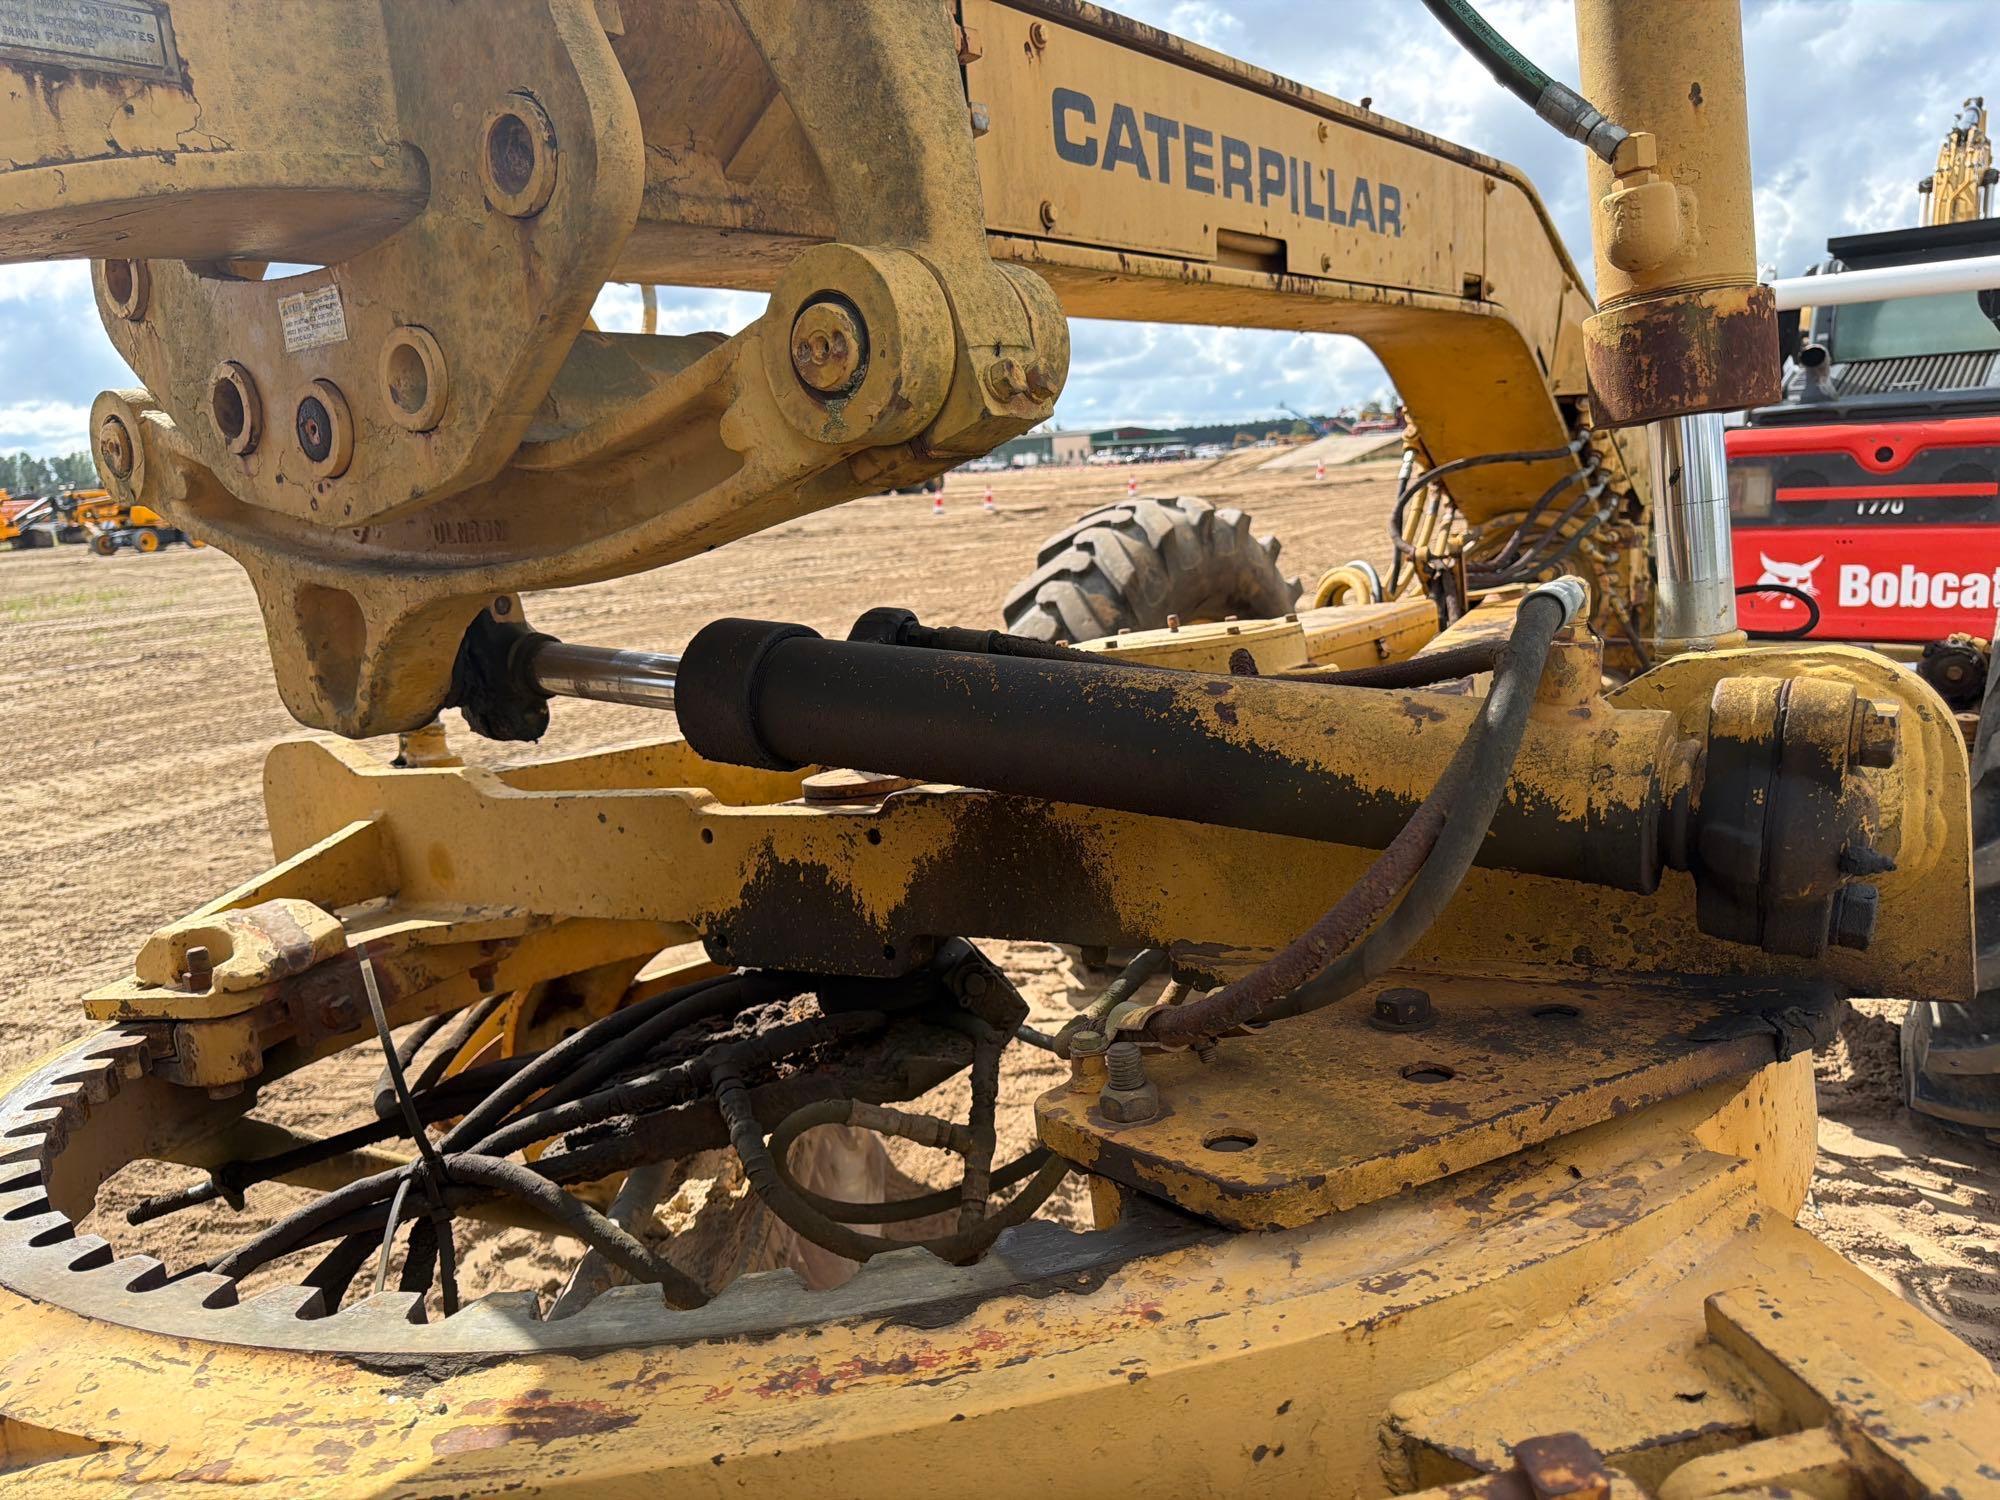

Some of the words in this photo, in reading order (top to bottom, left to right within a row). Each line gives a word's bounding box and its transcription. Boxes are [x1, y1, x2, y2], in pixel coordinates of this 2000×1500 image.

[2, 25, 39, 40] MAIN
[45, 31, 96, 49] FRAME
[103, 24, 156, 44] PLATES
[1052, 87, 1401, 238] CATERPILLAR
